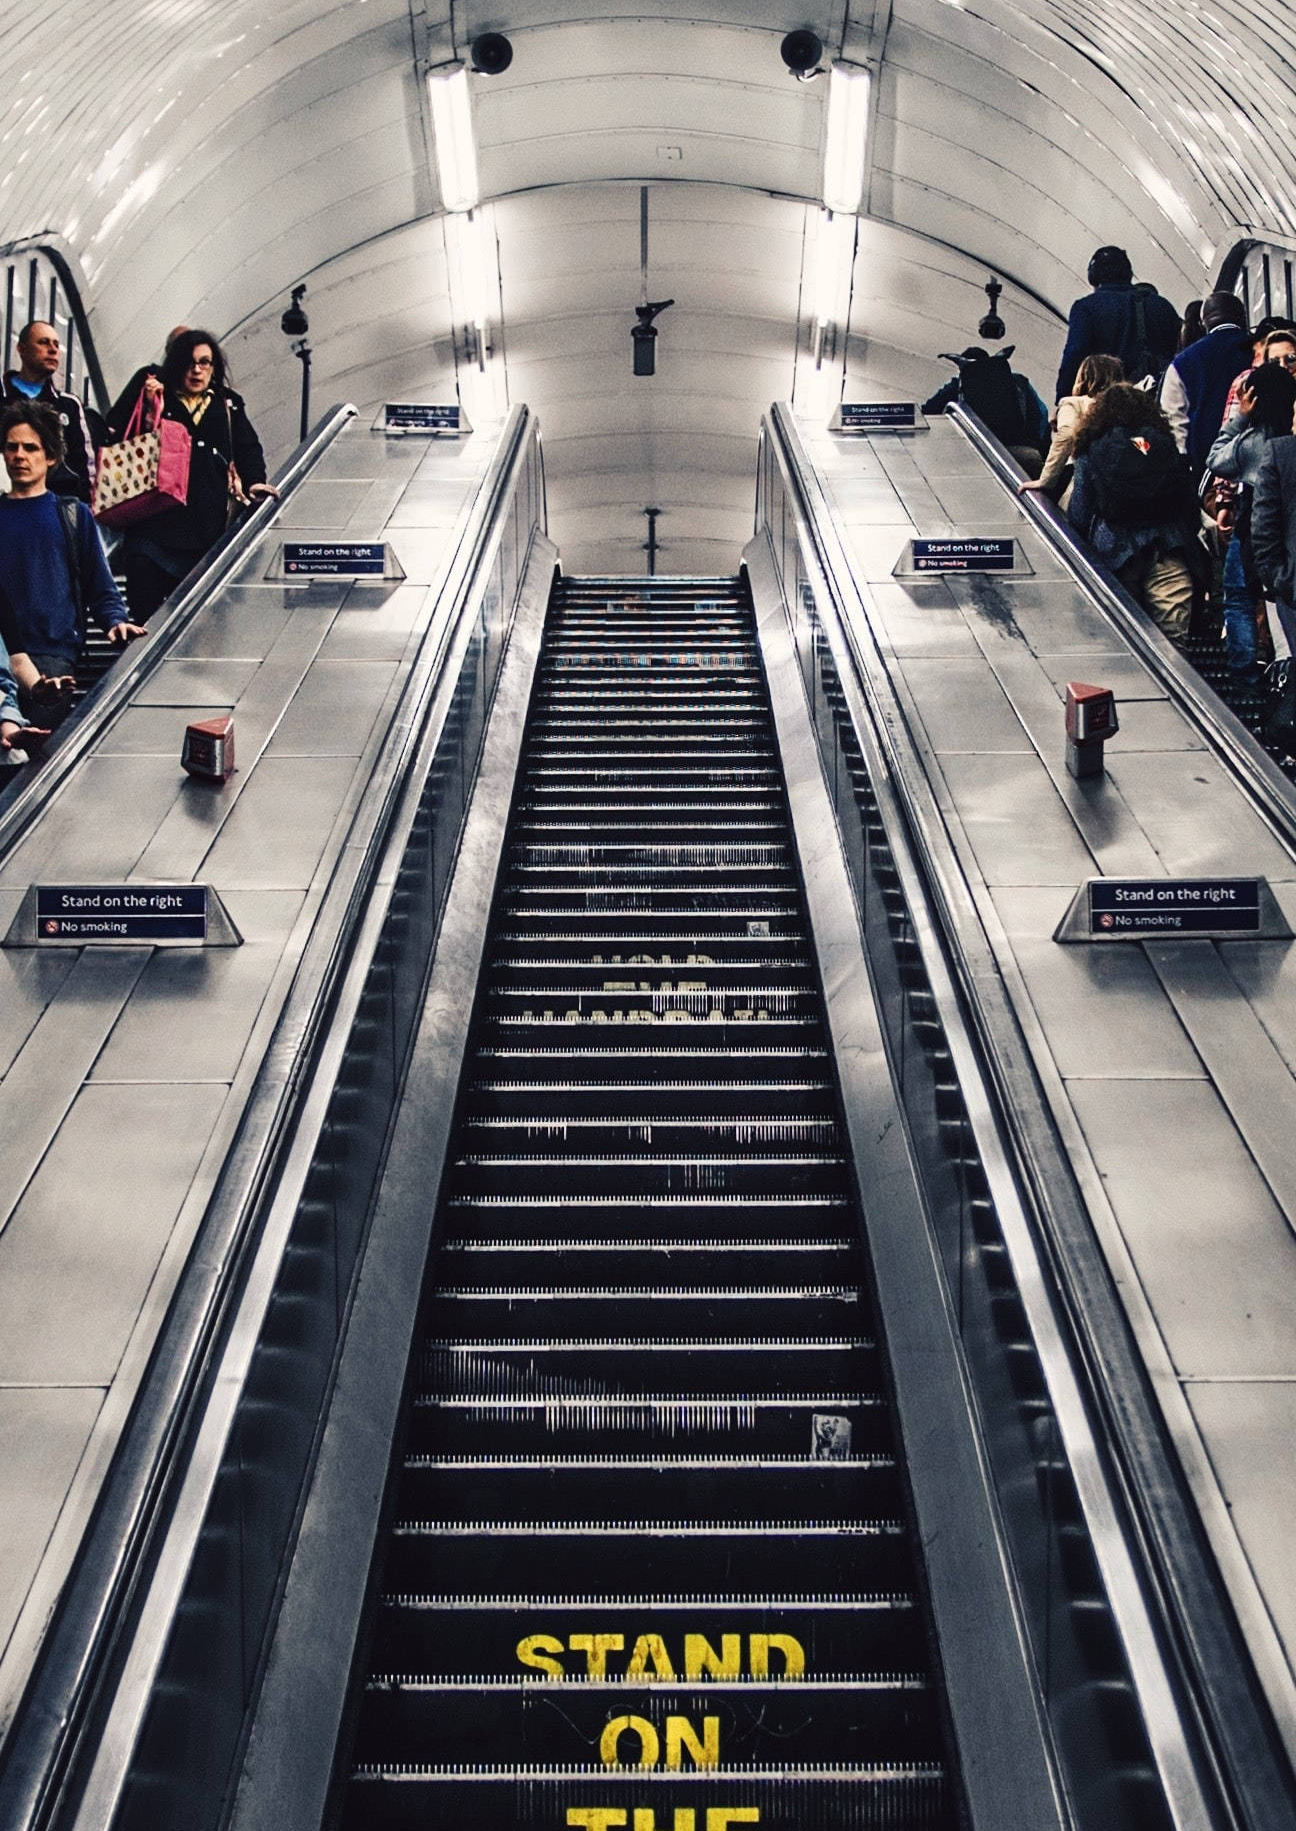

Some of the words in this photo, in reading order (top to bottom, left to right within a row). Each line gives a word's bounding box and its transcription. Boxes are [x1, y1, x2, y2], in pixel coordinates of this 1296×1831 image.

[298, 548, 322, 556] Stand
[351, 548, 371, 557] right
[927, 544, 951, 553] Stand
[964, 544, 979, 552] the
[980, 544, 1000, 553] right
[60, 894, 101, 908] Stand
[103, 897, 121, 907] on
[123, 895, 148, 907] the
[150, 894, 183, 910] right
[1115, 888, 1154, 902] Stand
[1156, 890, 1175, 901] on
[1176, 888, 1202, 900] the
[1203, 887, 1237, 903] right
[60, 922, 78, 932] No
[80, 921, 128, 934] smoking
[1115, 915, 1133, 926] No
[1134, 915, 1183, 928] smoking
[514, 1633, 806, 1682] STAND
[599, 1714, 722, 1772] ON
